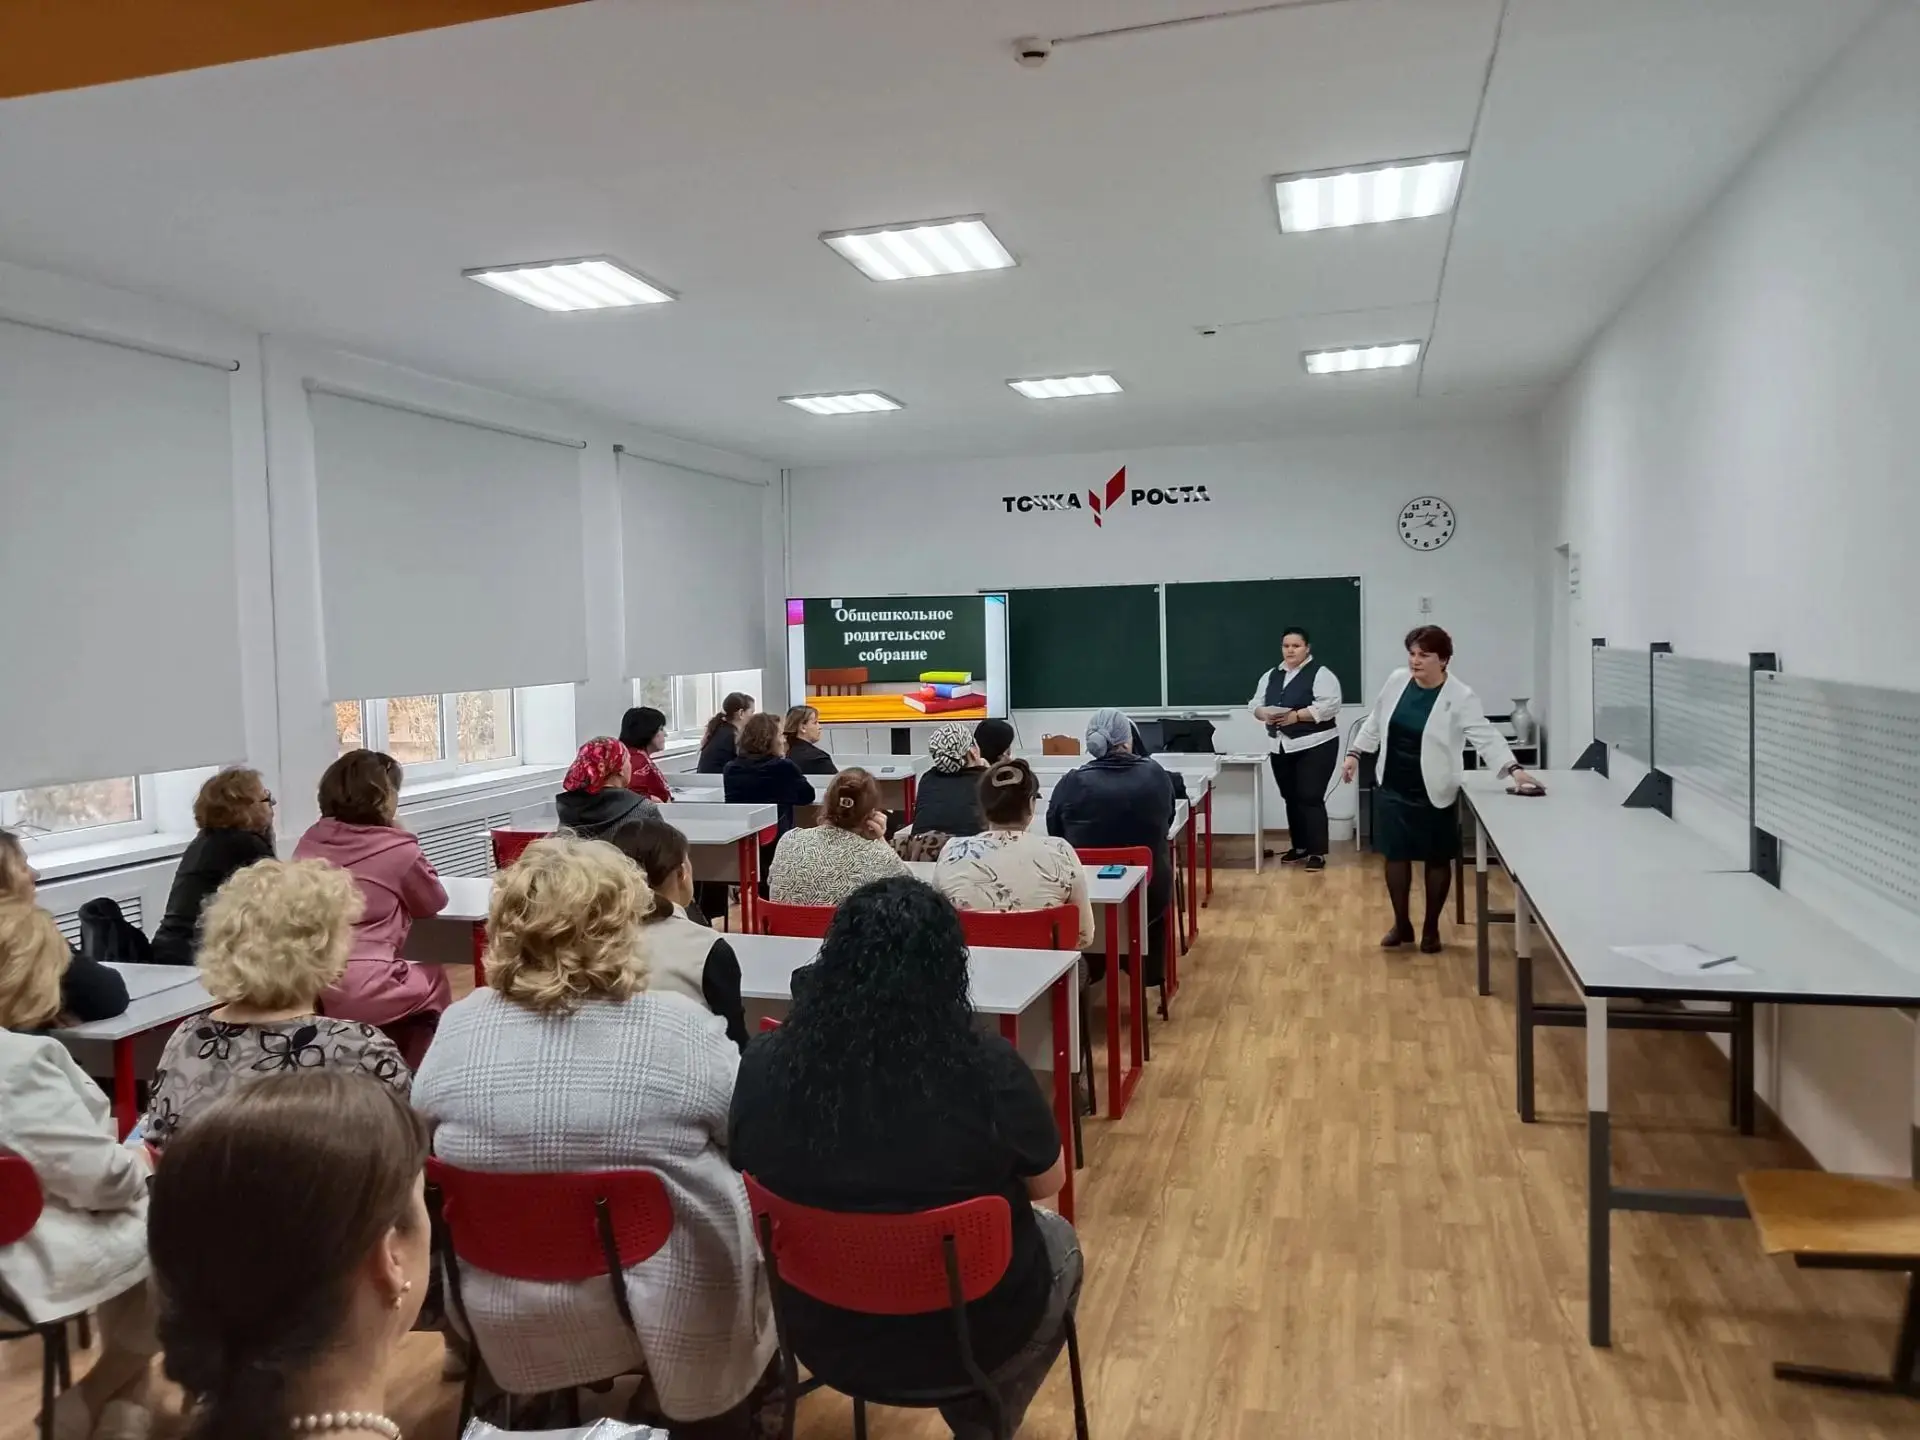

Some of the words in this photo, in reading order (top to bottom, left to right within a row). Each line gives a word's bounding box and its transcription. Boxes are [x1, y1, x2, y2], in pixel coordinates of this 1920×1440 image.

[1002, 493, 1082, 513] ТОЧКА
[1131, 485, 1211, 506] РОСТА
[835, 608, 954, 623] Общешкольное
[844, 628, 946, 645] родительское
[858, 647, 928, 664] собрание
